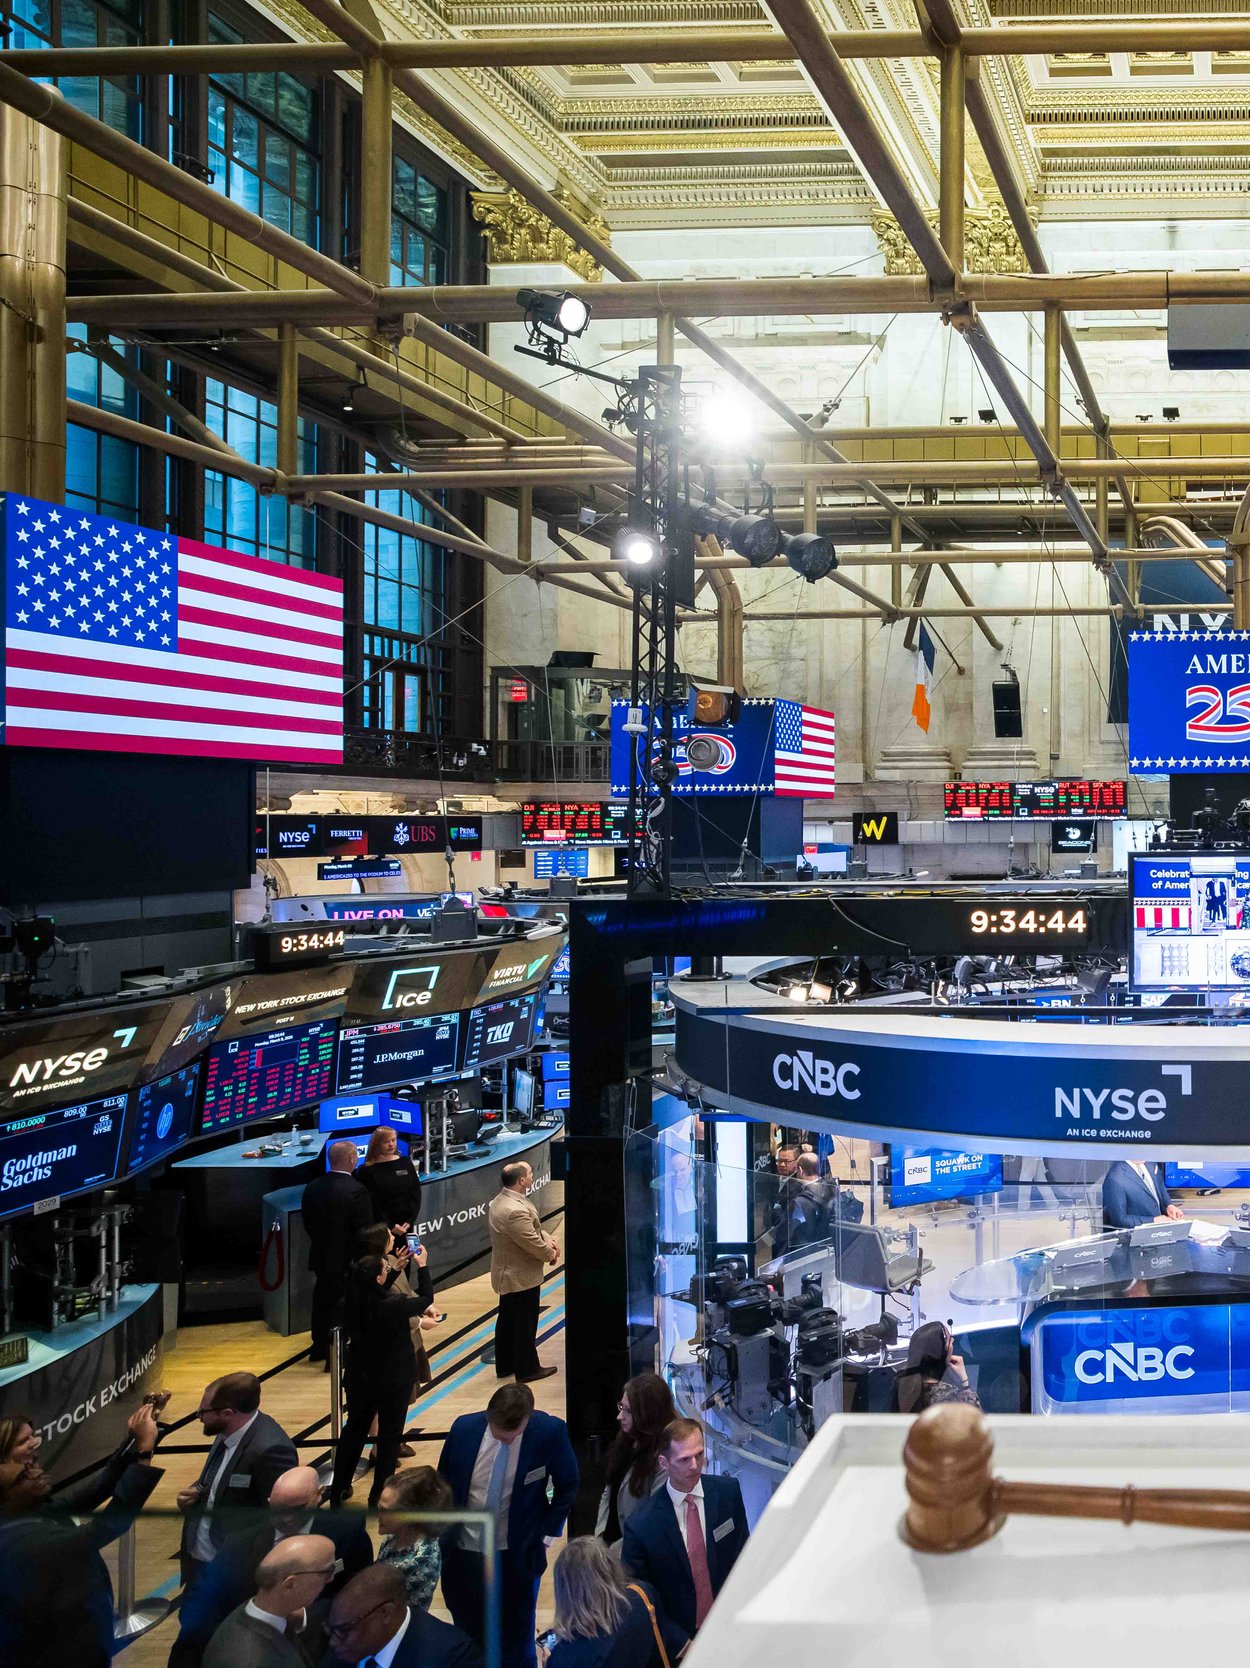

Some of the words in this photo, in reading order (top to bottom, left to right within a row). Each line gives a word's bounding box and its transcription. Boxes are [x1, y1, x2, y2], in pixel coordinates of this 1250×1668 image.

[330, 829, 363, 837] FERRETTI
[411, 826, 436, 842] UBS
[1152, 881, 1162, 889] of
[970, 910, 1086, 933] 9:34:44
[281, 931, 345, 952] 9:34:44
[493, 963, 527, 980] VIRTU
[489, 976, 523, 988] FINANCIAL
[235, 1004, 255, 1014] NEW
[256, 999, 279, 1010] YORK
[279, 994, 306, 1006] STOCK
[306, 987, 347, 1002] EXCHANGE
[344, 1028, 359, 1037] JPM
[486, 1021, 515, 1042] TKO
[373, 1049, 424, 1064] J.P.Morgan
[772, 1050, 860, 1100] CNBC
[13, 1089, 26, 1098] AN
[11, 1116, 46, 1131] 810.0000
[103, 1096, 125, 1108] 811.00
[99, 1114, 110, 1122] GS
[93, 1125, 112, 1136] NYSE
[1066, 1128, 1079, 1137] AN
[3, 1144, 77, 1176] Goldman
[754, 1153, 771, 1171] CNBC
[935, 1155, 972, 1167] SQUAWK
[972, 1154, 983, 1162] ON
[907, 1166, 928, 1175] CNBC
[935, 1167, 951, 1175] THE
[952, 1162, 982, 1173] STREET
[1, 1165, 52, 1192] Sachs
[446, 1203, 486, 1227] YORK
[1150, 1231, 1173, 1239] CNBC
[1074, 1250, 1097, 1258] CNBC
[1074, 1342, 1195, 1384] CNBC
[100, 1344, 157, 1408] EXCHANGE
